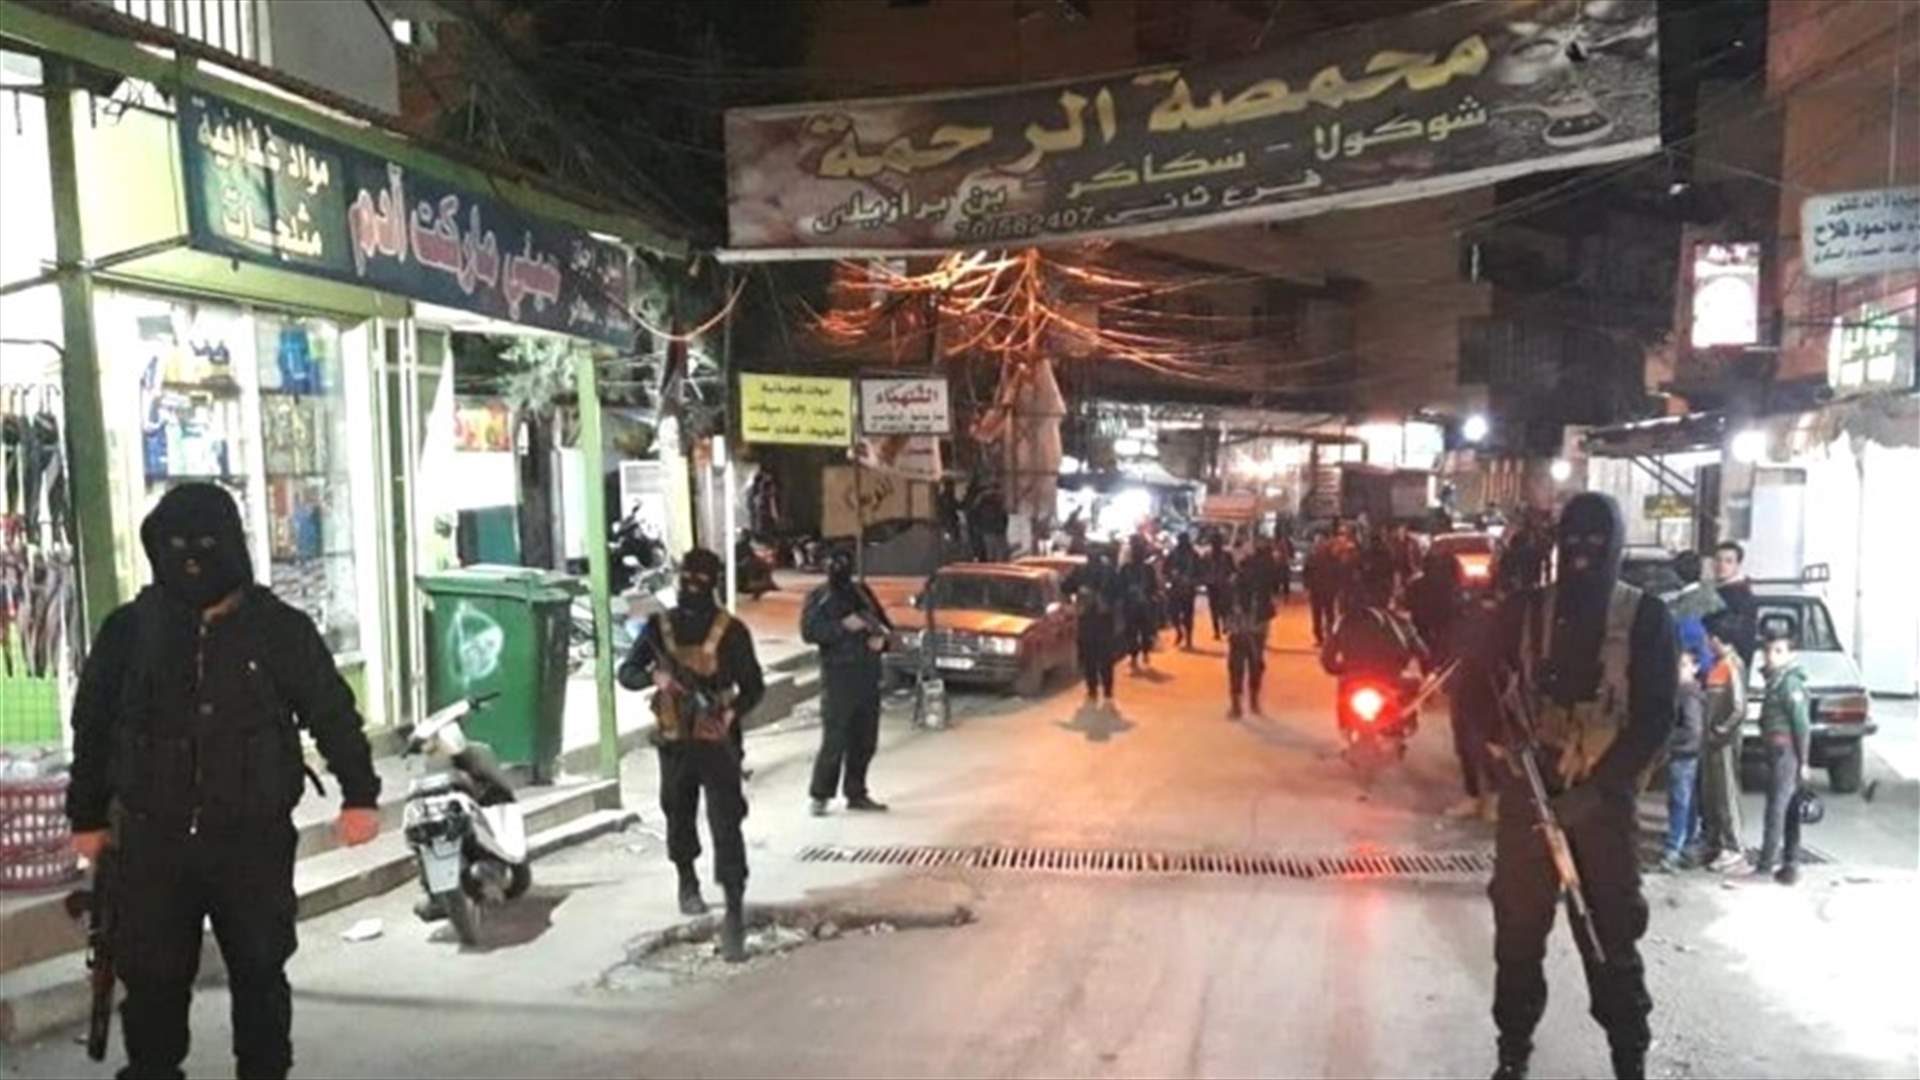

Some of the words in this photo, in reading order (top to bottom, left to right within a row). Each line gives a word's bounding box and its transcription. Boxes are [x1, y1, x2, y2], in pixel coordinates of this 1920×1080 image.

[1132, 34, 1490, 133] محمصة
[803, 86, 1116, 177] الرحمة
[1313, 96, 1488, 161] شوكولا
[289, 143, 329, 195] مواد
[1067, 150, 1246, 199] سكاكر
[1222, 168, 1323, 207] فرع
[223, 186, 323, 262] مثلجات
[410, 194, 499, 296] ماركت
